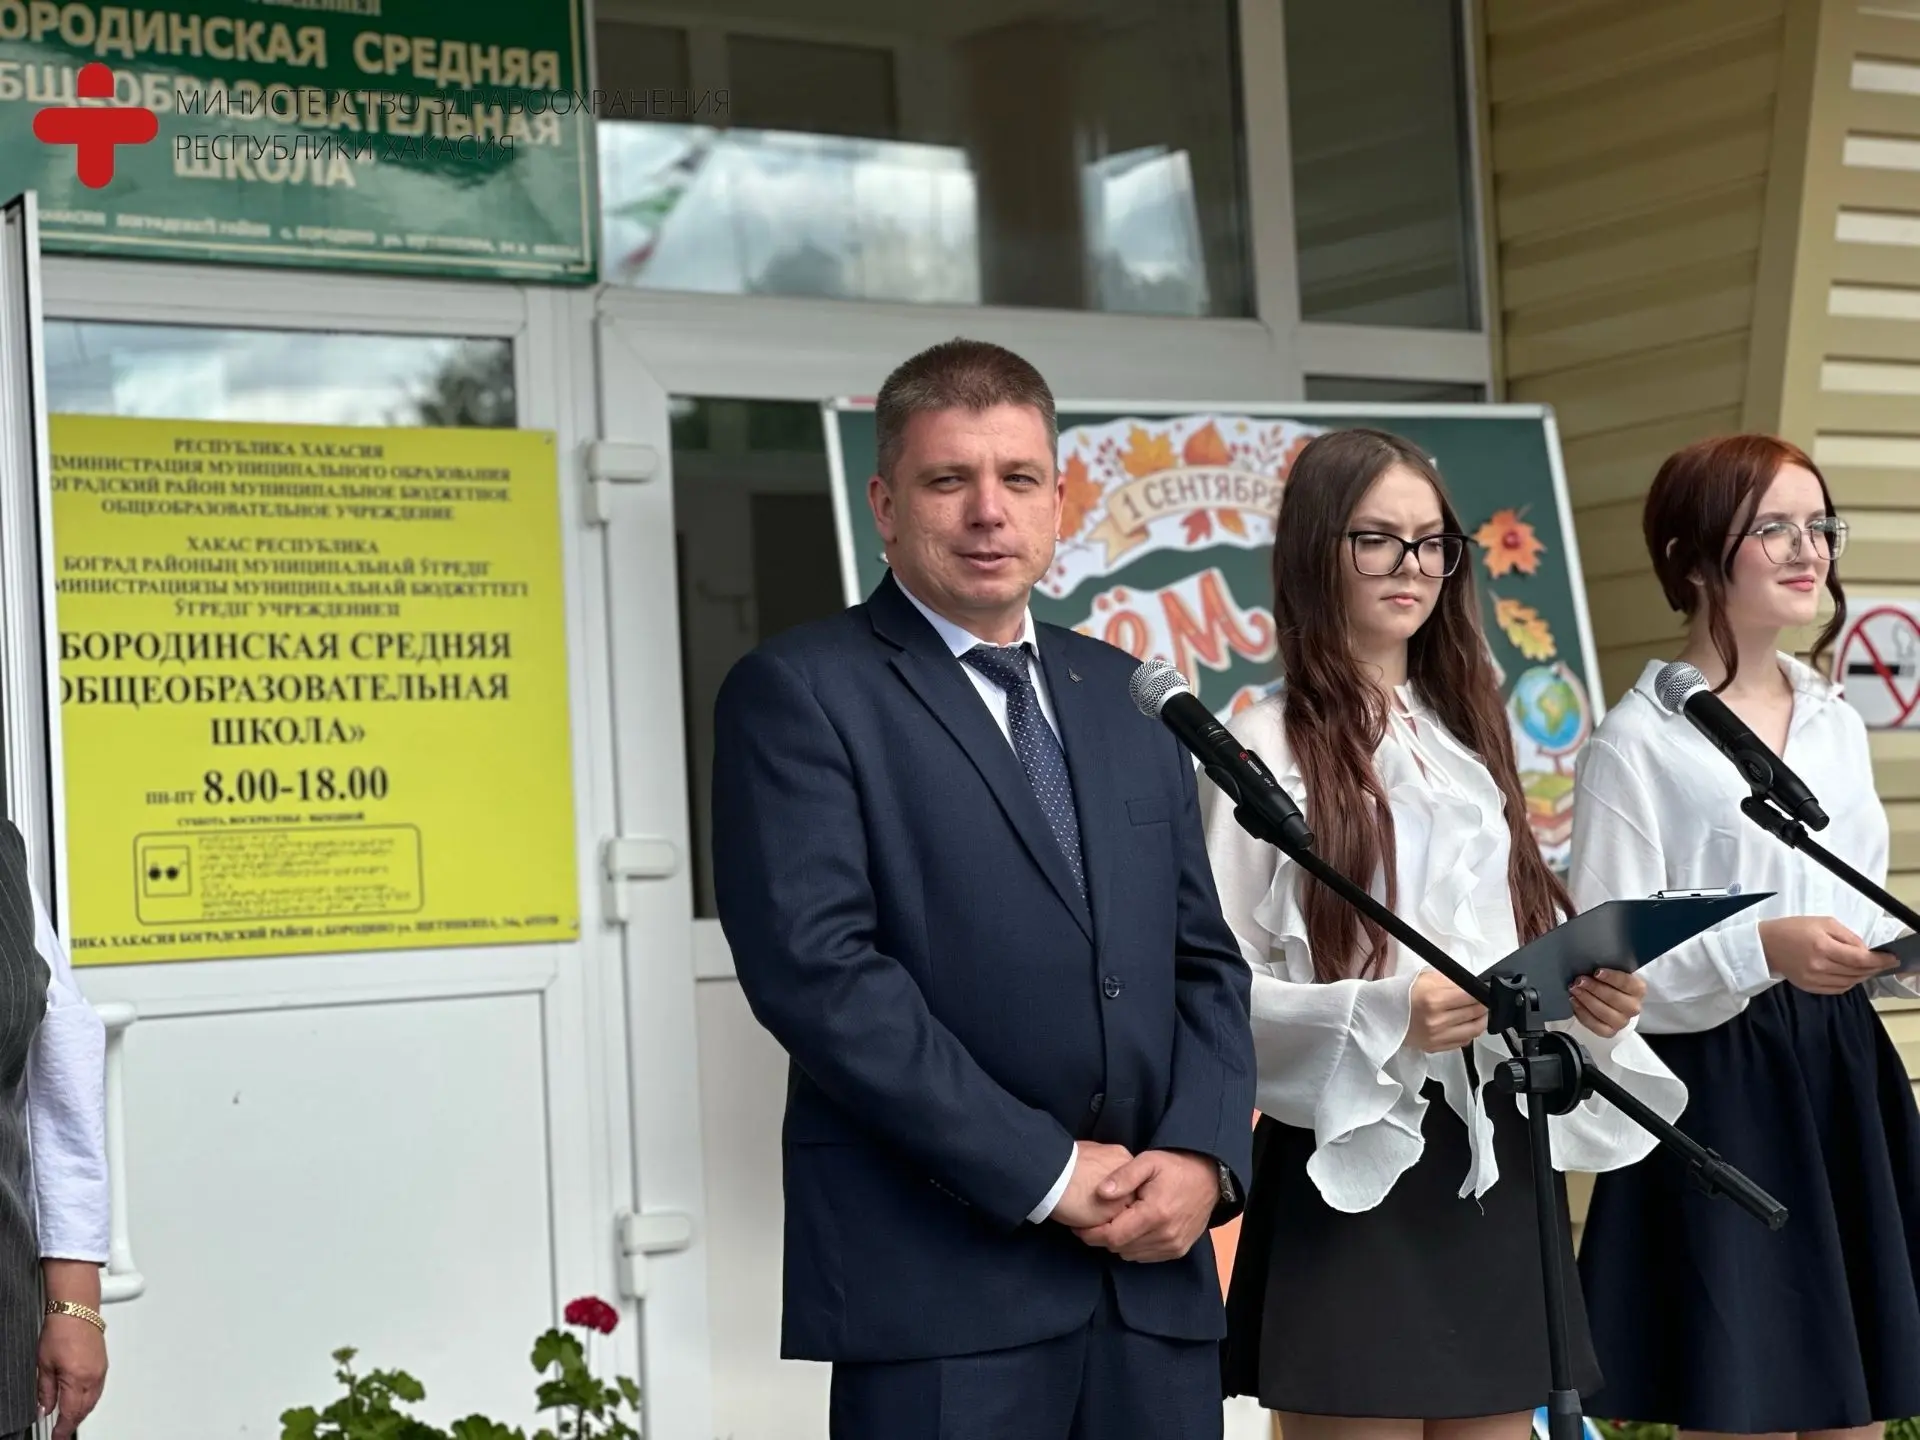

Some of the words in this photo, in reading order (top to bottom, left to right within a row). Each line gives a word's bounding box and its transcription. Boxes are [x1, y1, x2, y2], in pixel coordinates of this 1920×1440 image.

[353, 31, 560, 90] СРЕДНЯЯ
[0, 62, 560, 147] БЩОБРАЗОВАТЕЛЬНАЯ
[173, 438, 296, 456] РЕСПУБЛИКА
[300, 442, 384, 458] ХАКАСИЯ
[208, 459, 387, 479] МУНИЦИПАЛЬНОГО
[391, 466, 511, 481] ОБРАЗОВАНИЯ
[165, 476, 226, 494] РАЙОН
[231, 480, 395, 498] МУНИЦИПАЛЬНОЕ
[400, 485, 510, 502] БЮДЖЕТНОЕ
[1121, 493, 1144, 521] 1
[1143, 472, 1284, 511] СЕНТЯБРЯ
[101, 499, 329, 518] ОБЩЕОБРАЗОВАТЕЛЬНОЕ
[337, 504, 455, 522] УЧРЕЖДЕНИЕ
[187, 536, 249, 553] ХАКАС
[255, 537, 380, 554] РЕСПУБЛИКА
[64, 556, 137, 574] БОГРАД
[60, 632, 341, 667] БОРОДИНСКАЯ
[350, 632, 512, 663] СРЕДНЯЯ
[211, 717, 366, 748] ШКОЛА»
[203, 766, 389, 805] 8.00-18.00
[110, 932, 176, 947] ХАКАСИЯ
[179, 927, 266, 943] БОГРАДСКИЙ
[270, 925, 314, 940] РАЙОН
